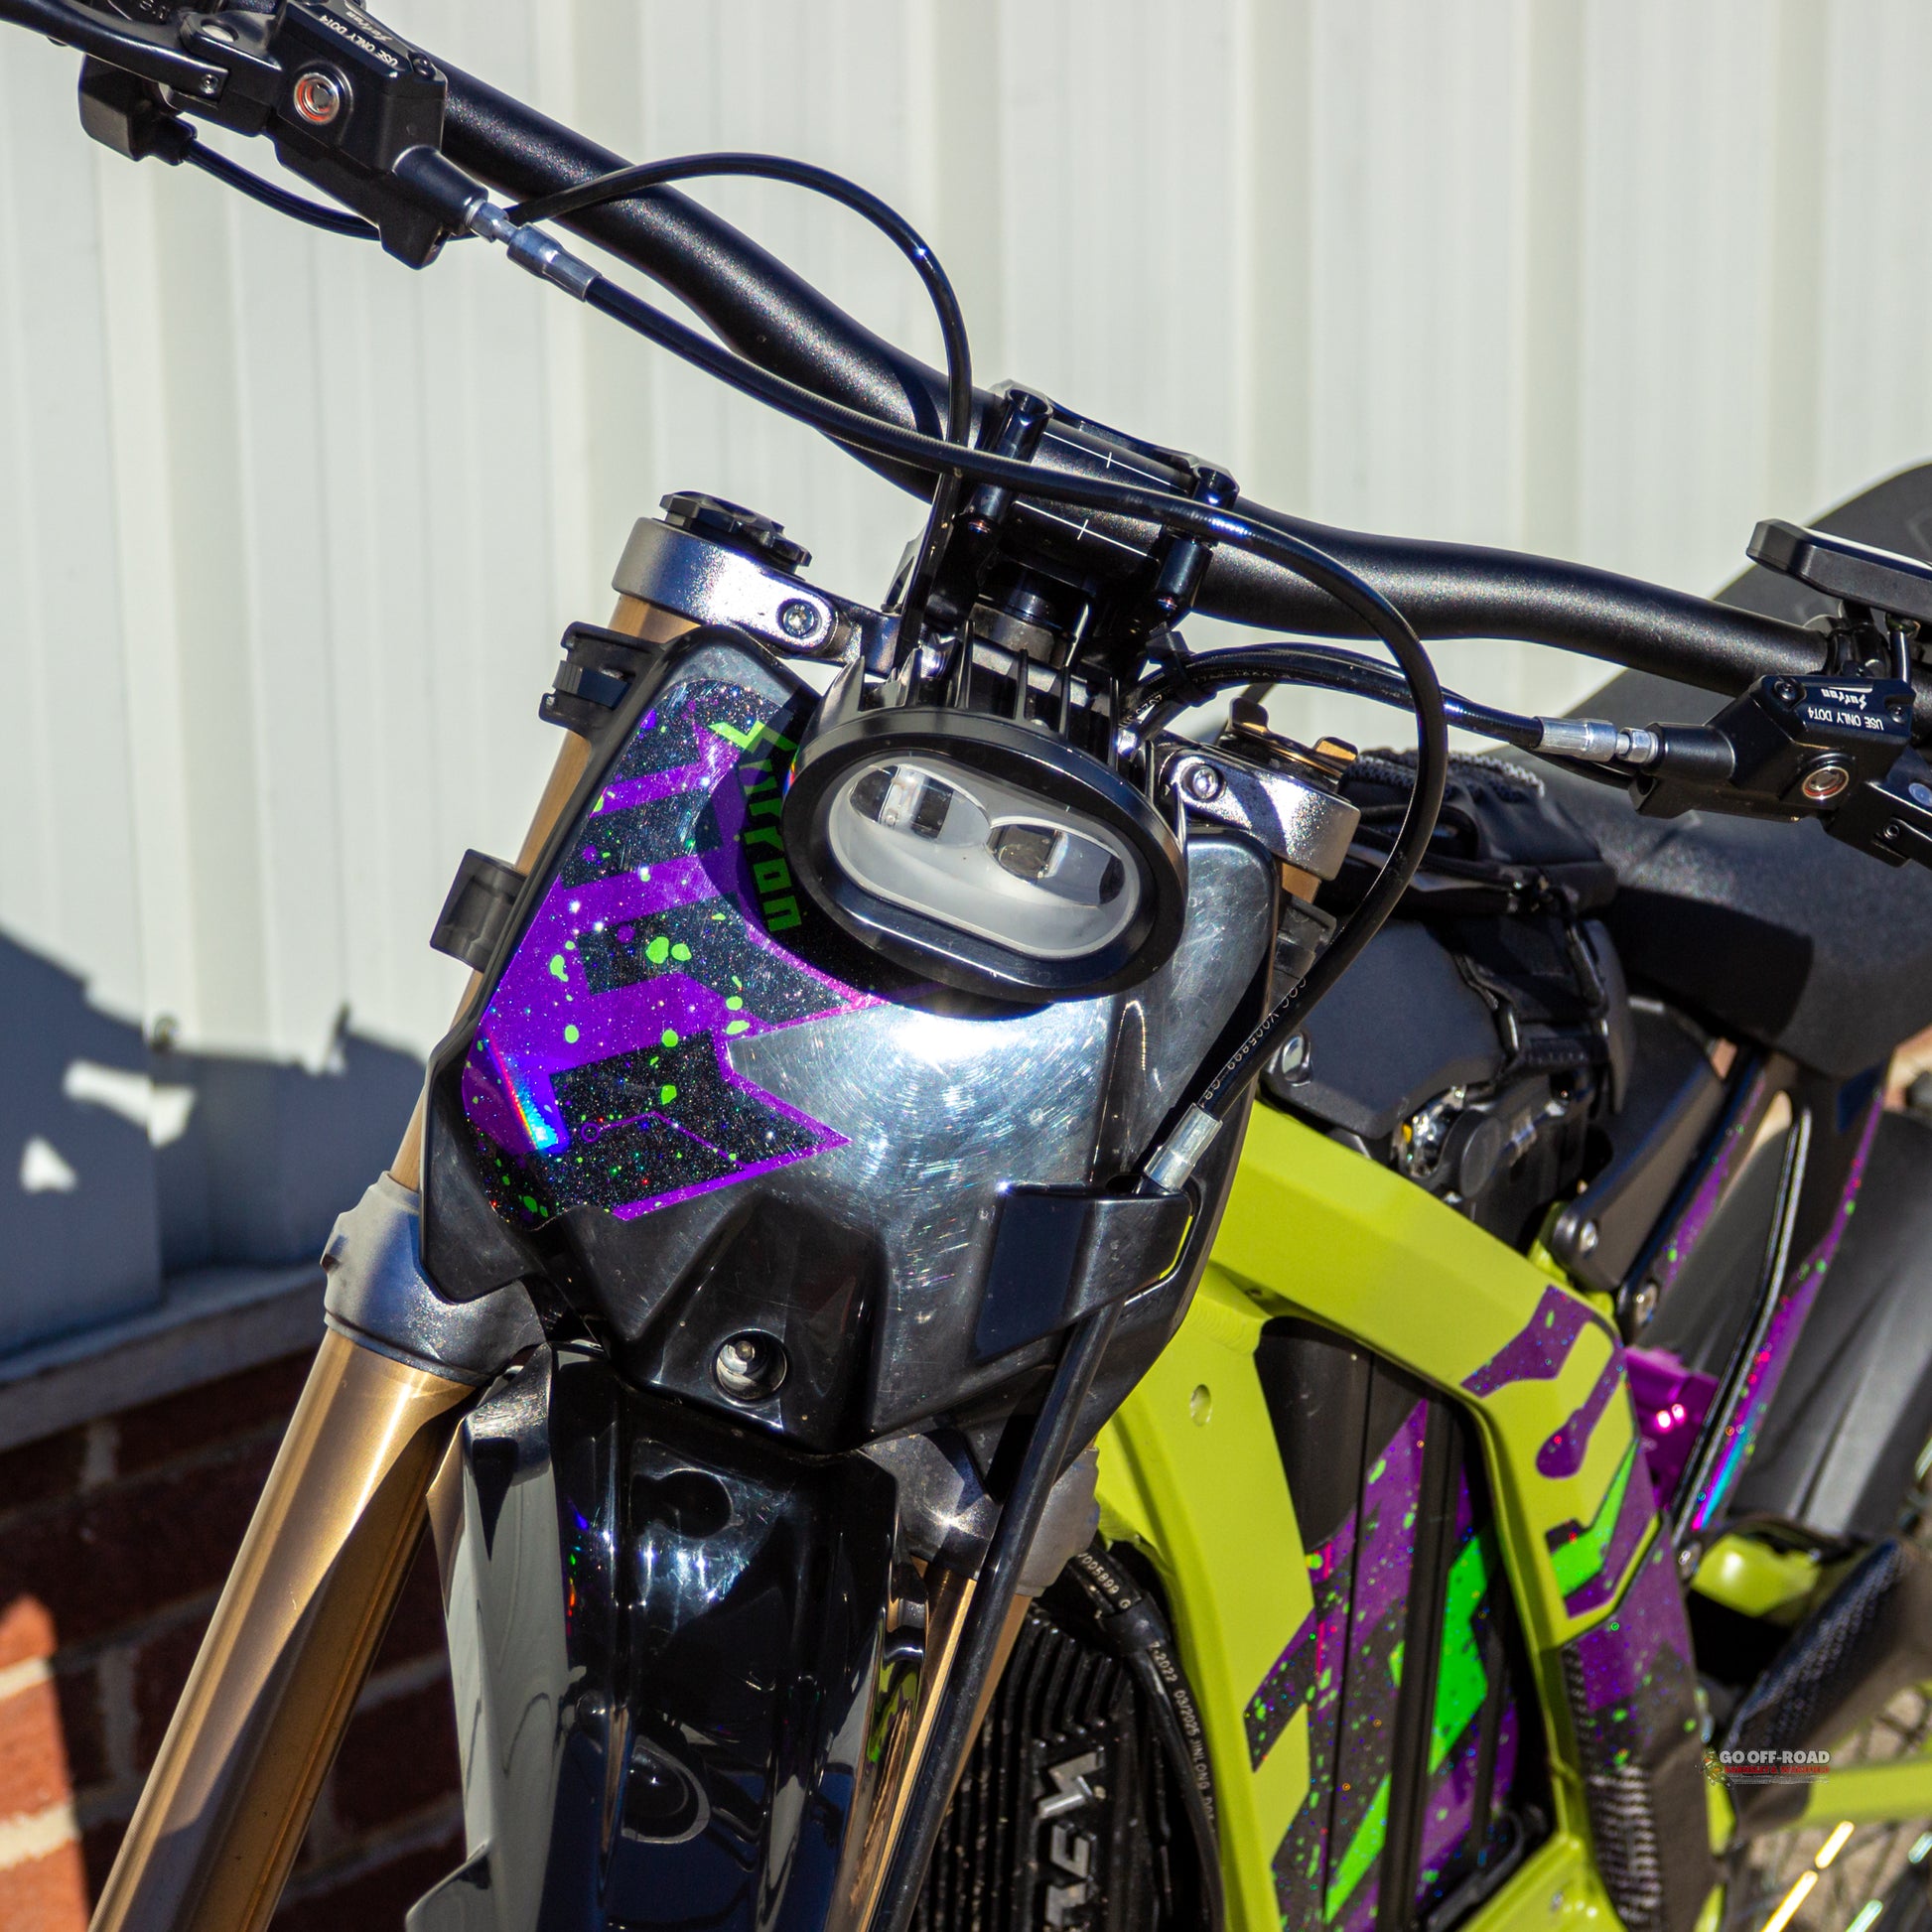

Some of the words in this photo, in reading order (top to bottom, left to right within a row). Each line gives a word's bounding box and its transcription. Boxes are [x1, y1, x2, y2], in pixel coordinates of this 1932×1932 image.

[318, 14, 348, 36] DOT4
[345, 32, 376, 53] ONLY
[376, 49, 398, 67] USE
[1807, 706, 1834, 723] DOT4
[1836, 711, 1863, 728] ONLY
[1863, 716, 1884, 731] USE
[708, 720, 803, 932] Surron
